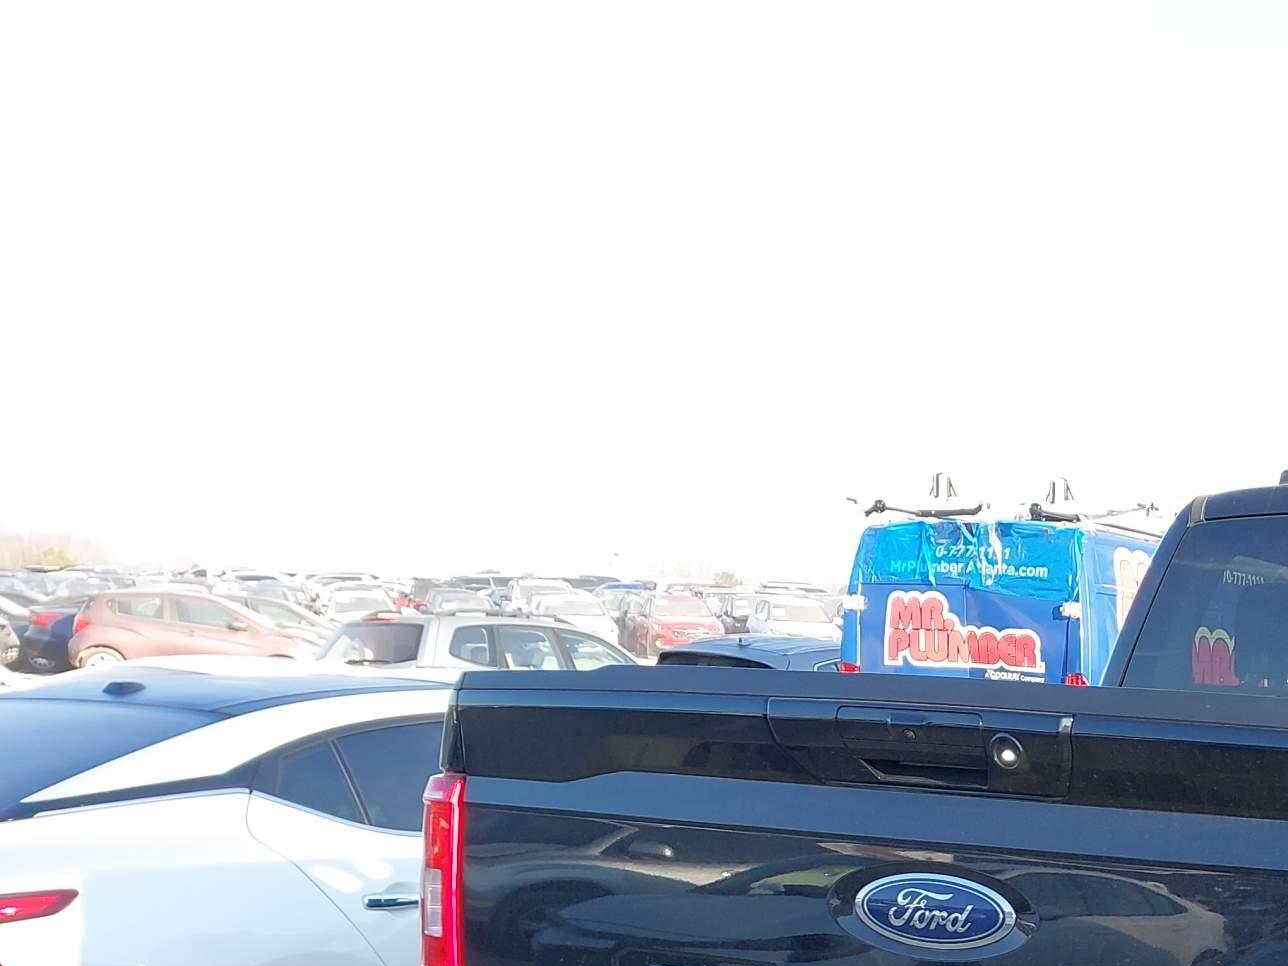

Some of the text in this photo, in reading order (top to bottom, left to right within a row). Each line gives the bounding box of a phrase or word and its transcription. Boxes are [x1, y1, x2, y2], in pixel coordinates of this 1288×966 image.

[890, 596, 955, 630] MR.
[888, 628, 1037, 668] PLUMBER
[888, 887, 974, 933] Ford
